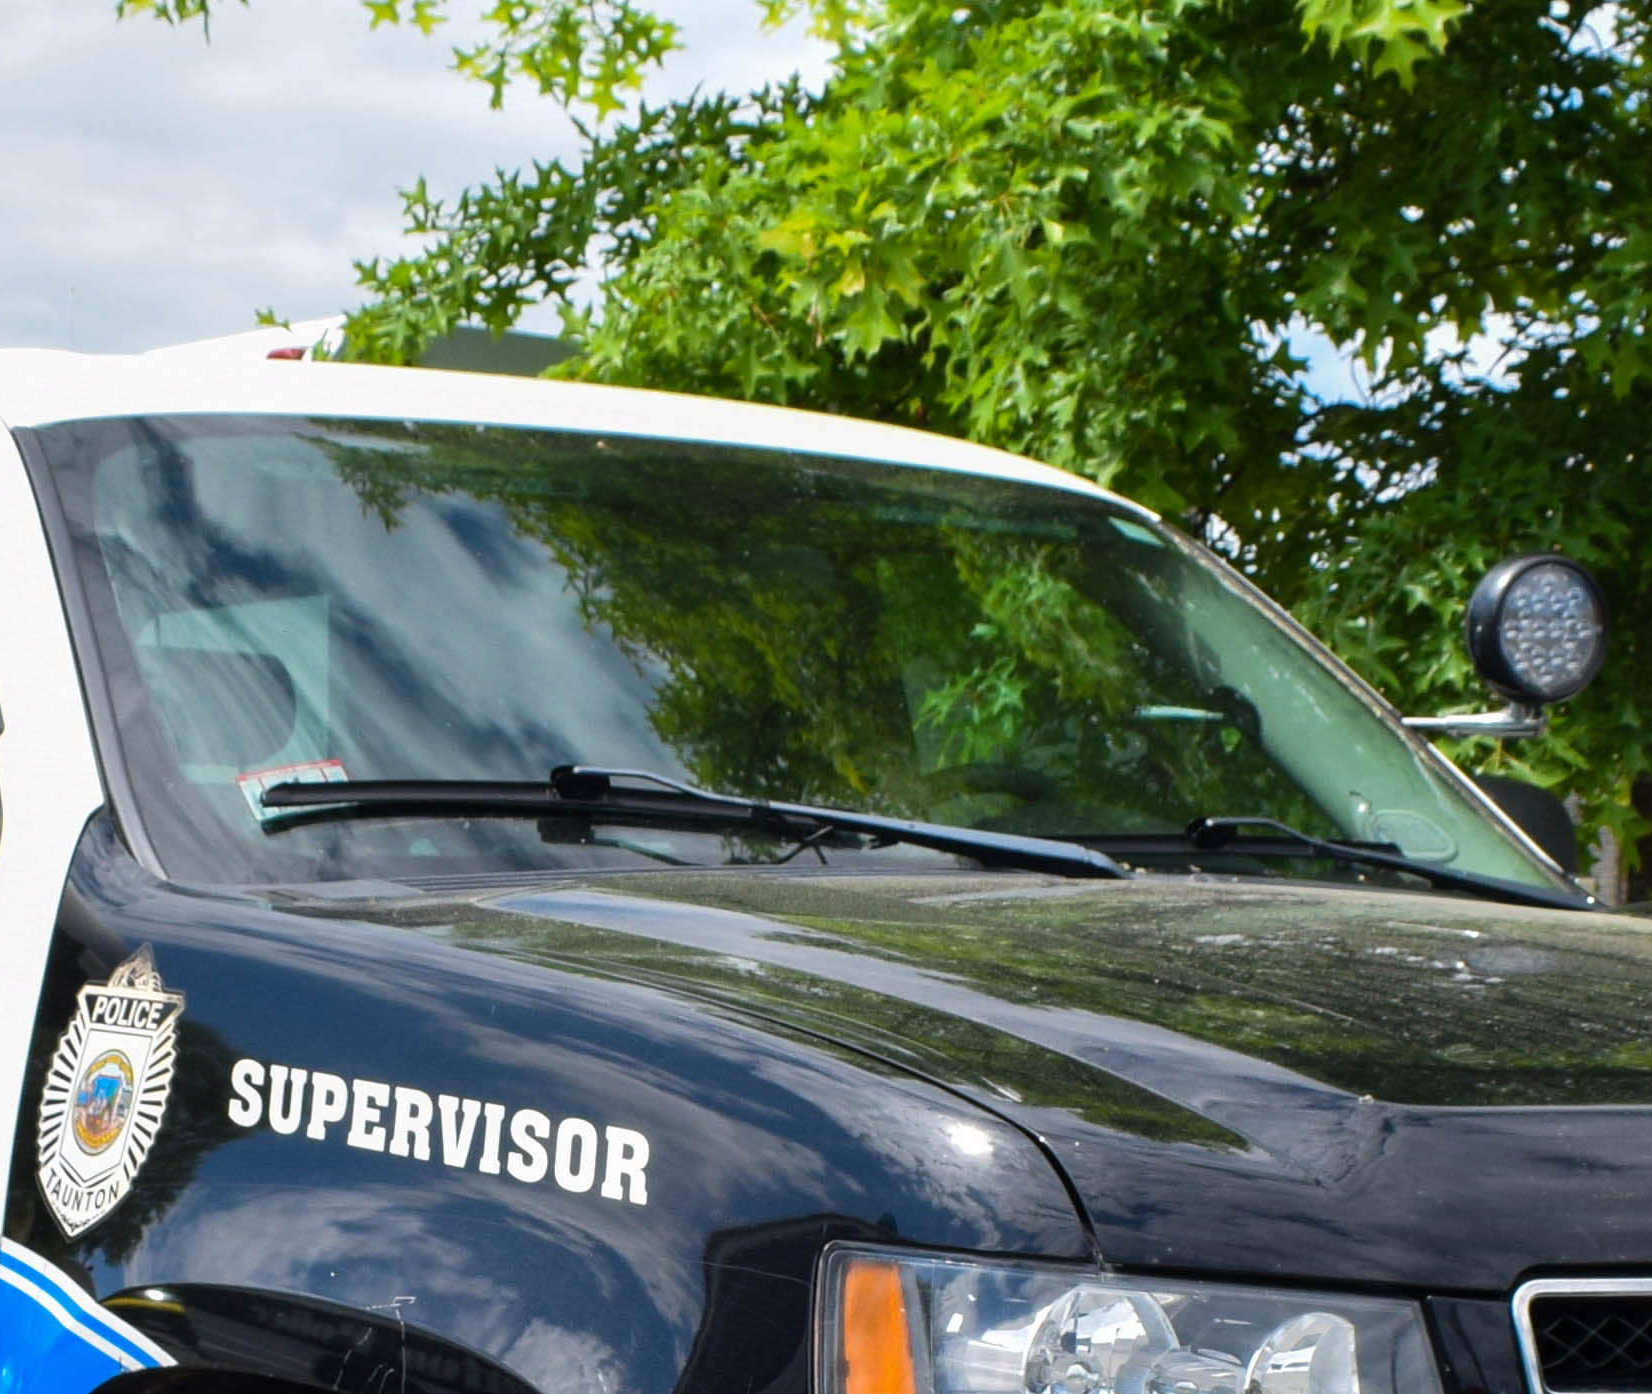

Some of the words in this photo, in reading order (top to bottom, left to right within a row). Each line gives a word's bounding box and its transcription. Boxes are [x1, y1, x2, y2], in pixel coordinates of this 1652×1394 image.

[91, 996, 164, 1030] POLICE
[228, 1058, 649, 1205] SUPERVISOR
[45, 1168, 120, 1213] TAUNTON
